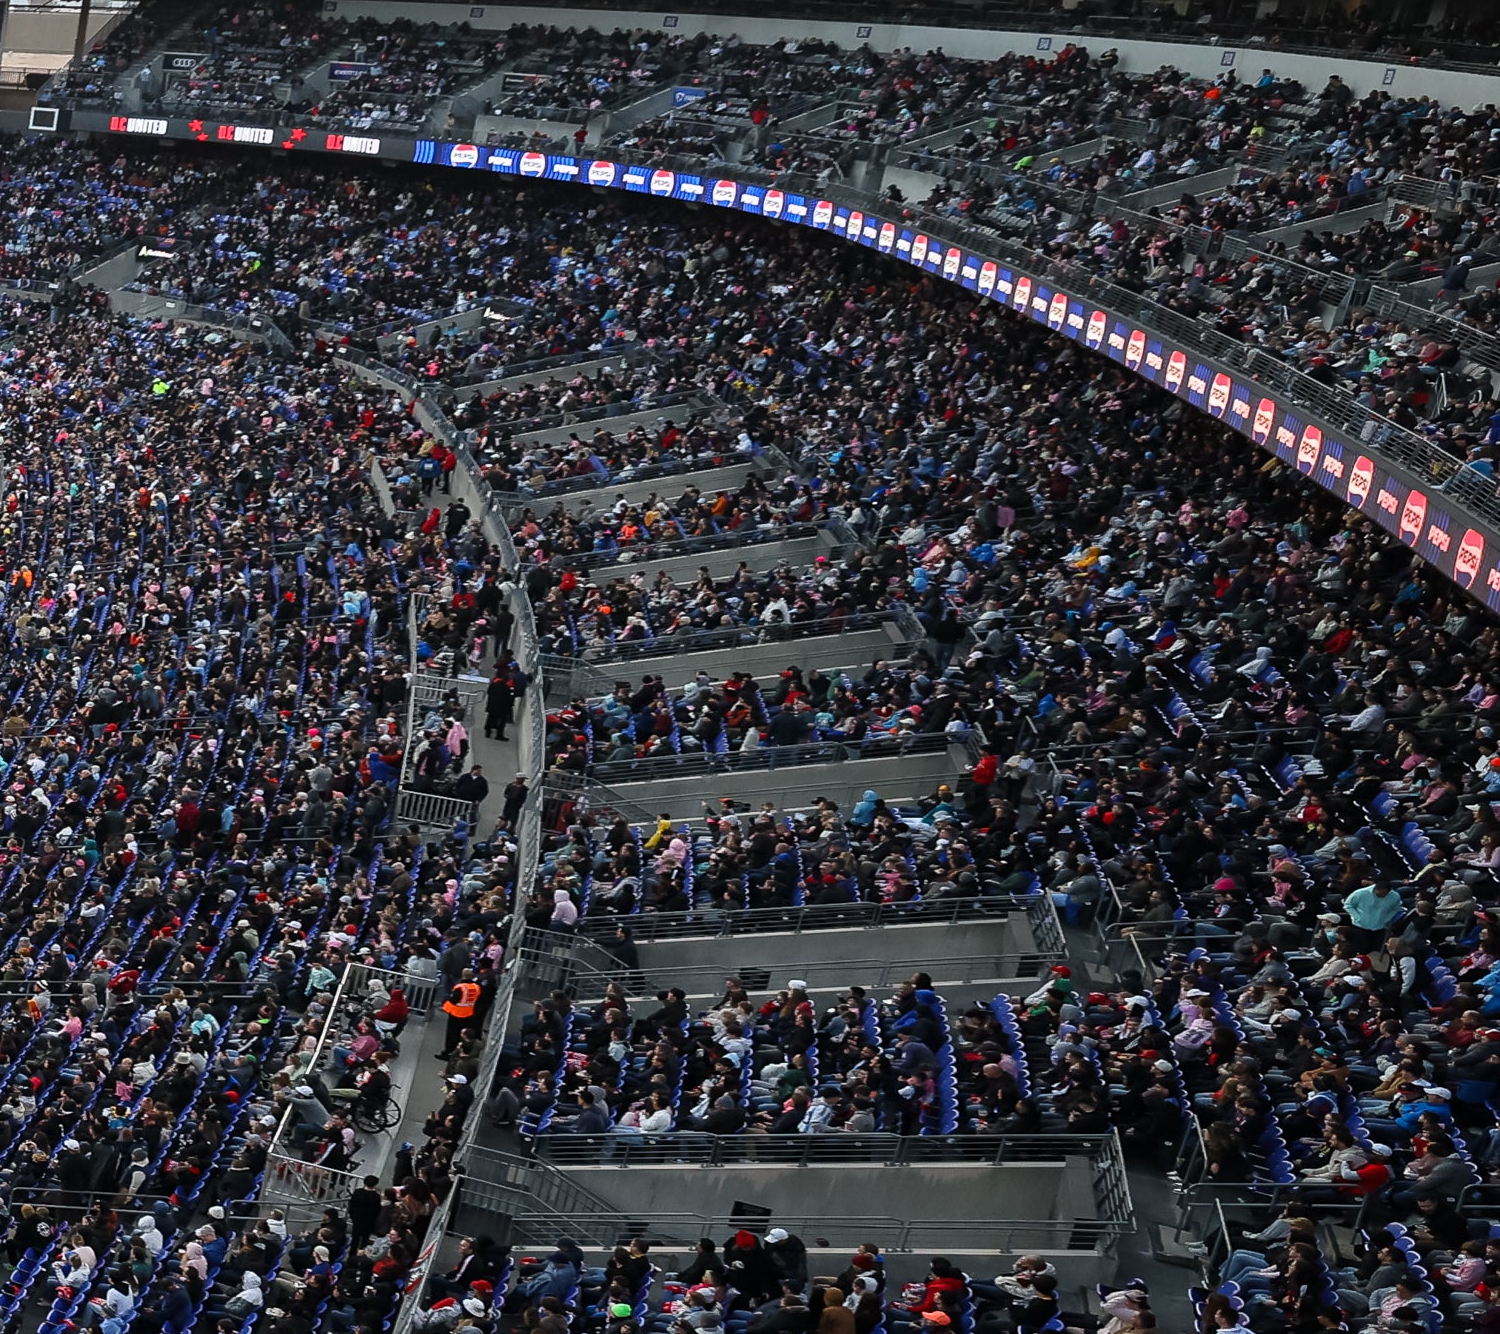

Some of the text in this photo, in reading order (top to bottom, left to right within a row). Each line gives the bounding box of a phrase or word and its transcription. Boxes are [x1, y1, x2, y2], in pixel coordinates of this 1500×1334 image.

[127, 118, 168, 135] UNITED
[234, 127, 274, 144] UNITED
[342, 136, 380, 155] UNITED
